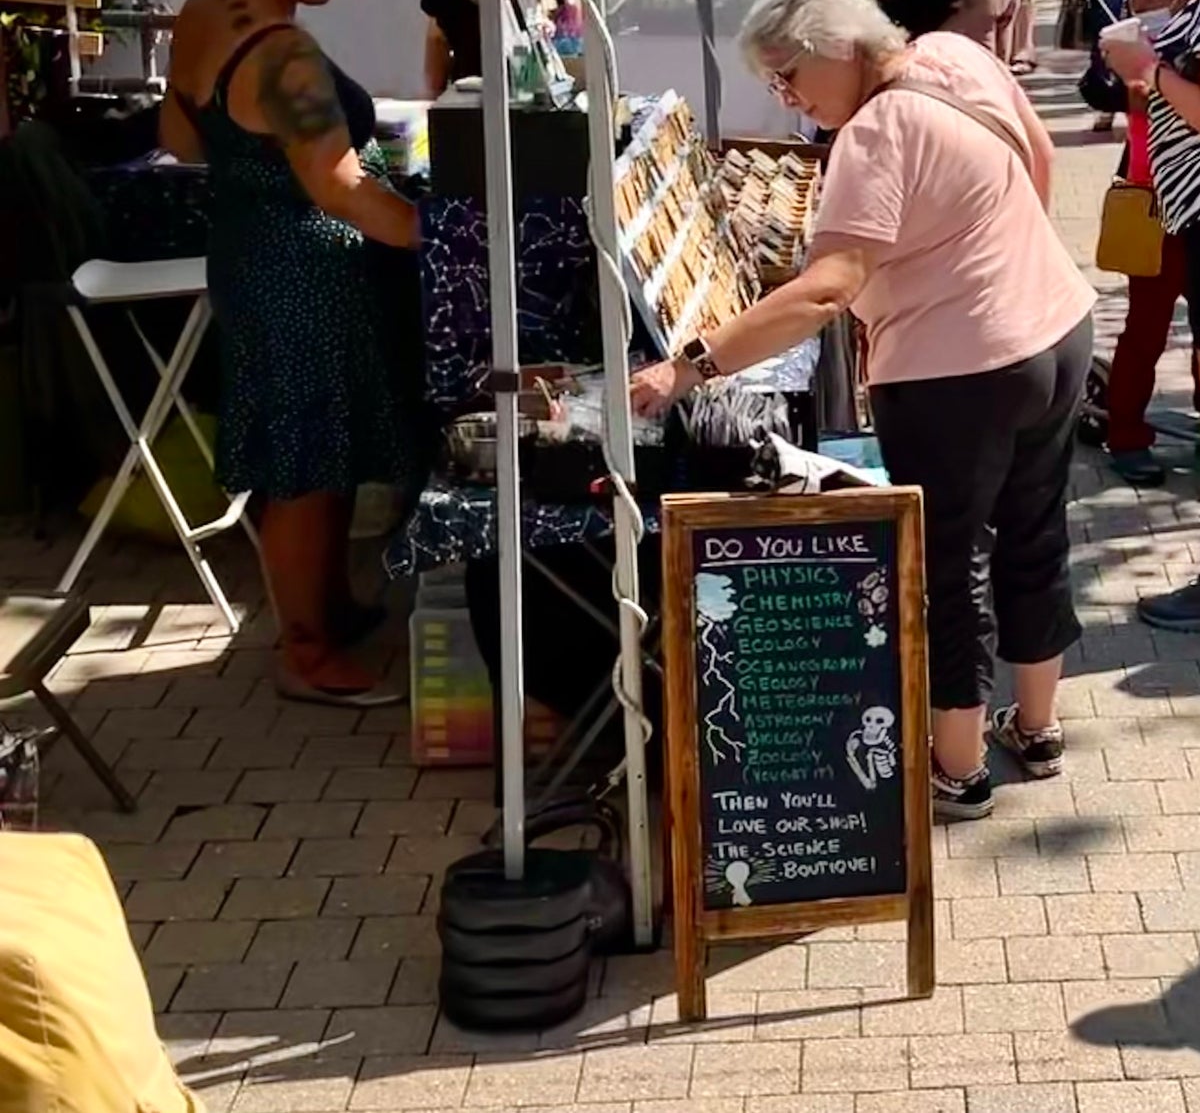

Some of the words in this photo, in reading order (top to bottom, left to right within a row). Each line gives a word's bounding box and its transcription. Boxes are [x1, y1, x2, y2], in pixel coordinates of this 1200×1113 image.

[705, 538, 743, 560] DO
[756, 536, 803, 558] YOU
[812, 534, 869, 554] LIKE
[743, 566, 840, 588] PHYSICS
[740, 591, 853, 613] CHEMISTRY
[733, 614, 854, 635] GEOSCIENCE
[739, 636, 821, 654] ECOLOGY
[739, 674, 820, 691] GEOLOGY
[742, 692, 861, 710] METEOROLOGY
[744, 711, 835, 728] ASTRONOMY
[746, 729, 815, 747] BIOLOGY
[747, 749, 822, 765] ZOOLOGY
[712, 790, 769, 811] THEN
[780, 791, 836, 810] YOU'LL
[718, 818, 767, 834] LOVE
[775, 816, 813, 834] OUR
[816, 812, 868, 834] SHOP!
[713, 841, 749, 859] THE
[761, 838, 840, 858] SCIENCE
